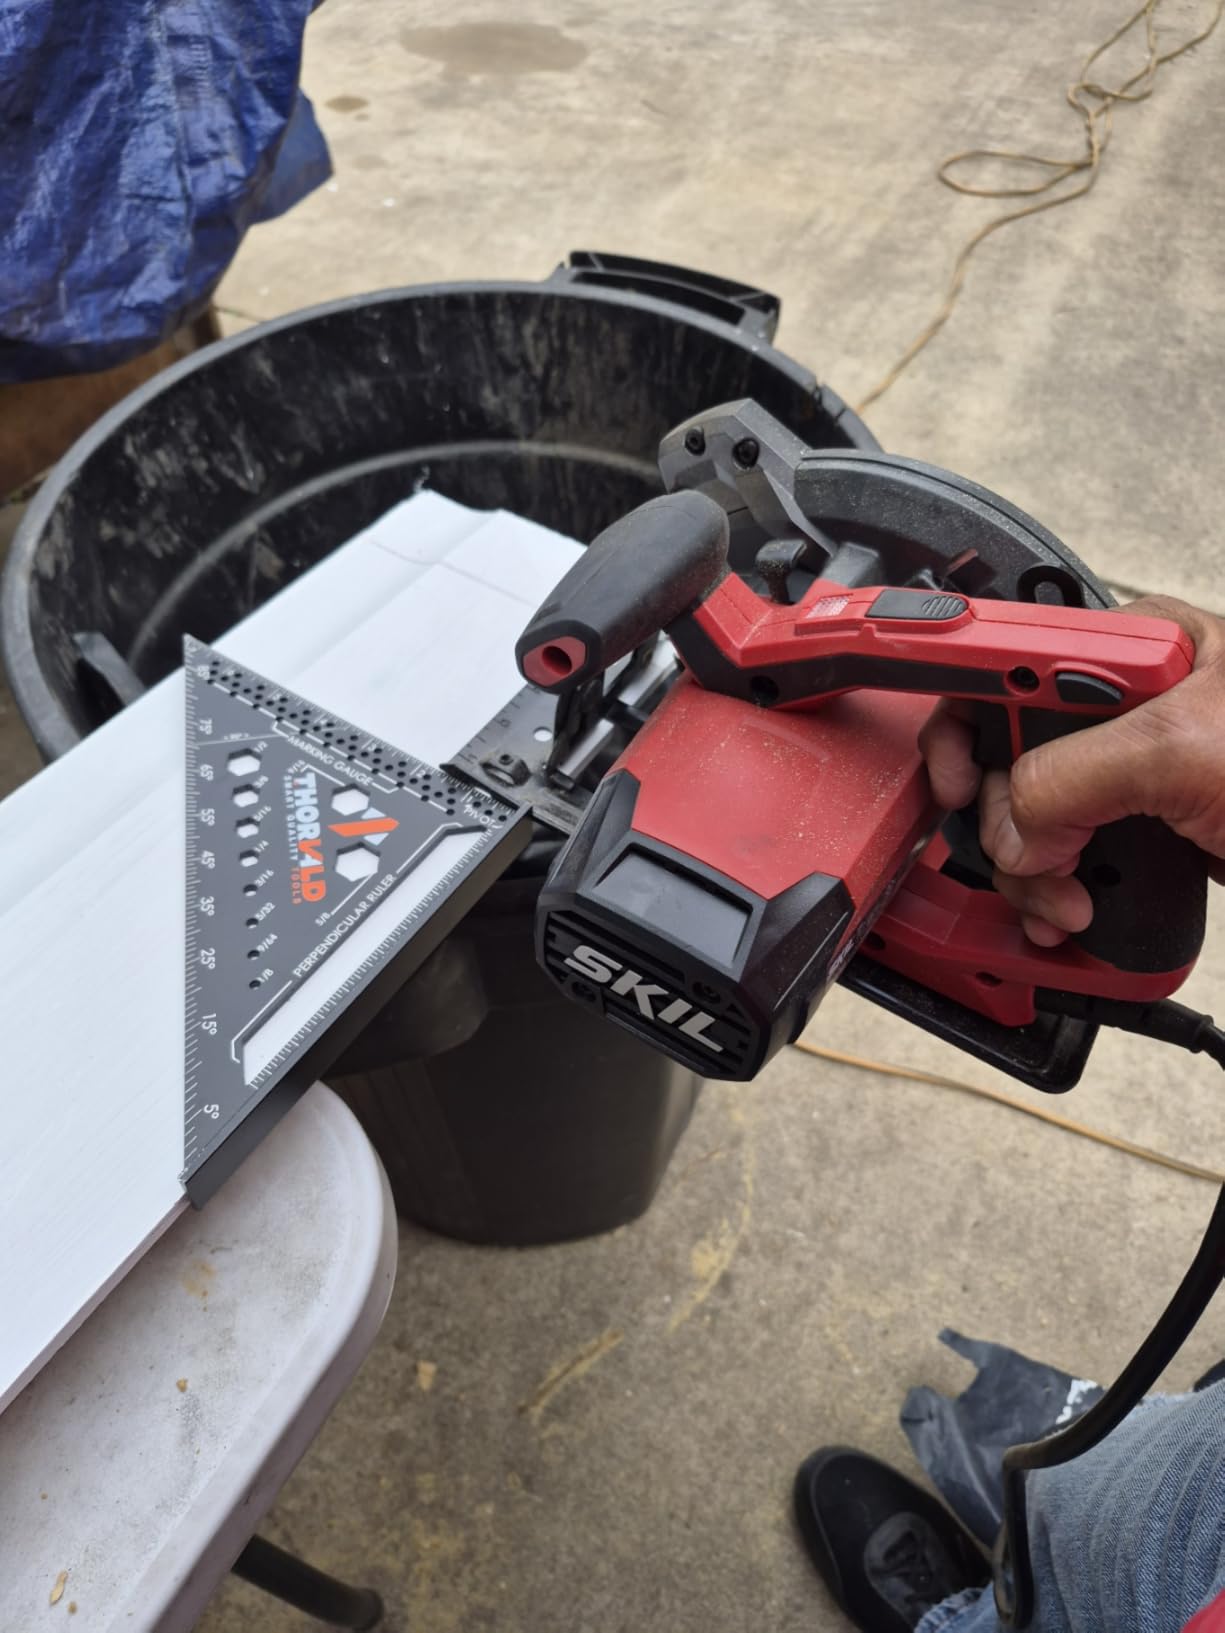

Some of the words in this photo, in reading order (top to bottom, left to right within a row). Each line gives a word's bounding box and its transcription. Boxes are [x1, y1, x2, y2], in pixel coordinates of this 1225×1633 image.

[287, 736, 335, 765] MARKING
[334, 760, 374, 786] GAUGE
[283, 775, 295, 809] SMART
[464, 807, 496, 826] PIVOT
[254, 840, 269, 852] 1/4
[286, 815, 299, 860] QUALITY
[292, 772, 326, 902] THORVALD
[254, 869, 274, 887] 3/16
[290, 867, 302, 905] TOOLS
[255, 902, 276, 921] 5/32
[315, 912, 331, 926] 5/8
[293, 901, 370, 977] PERPENDICULAR
[366, 873, 398, 902] RULER
[256, 933, 278, 952] 9/64
[257, 968, 274, 982] 1/8
[563, 945, 724, 1053] SKIL
